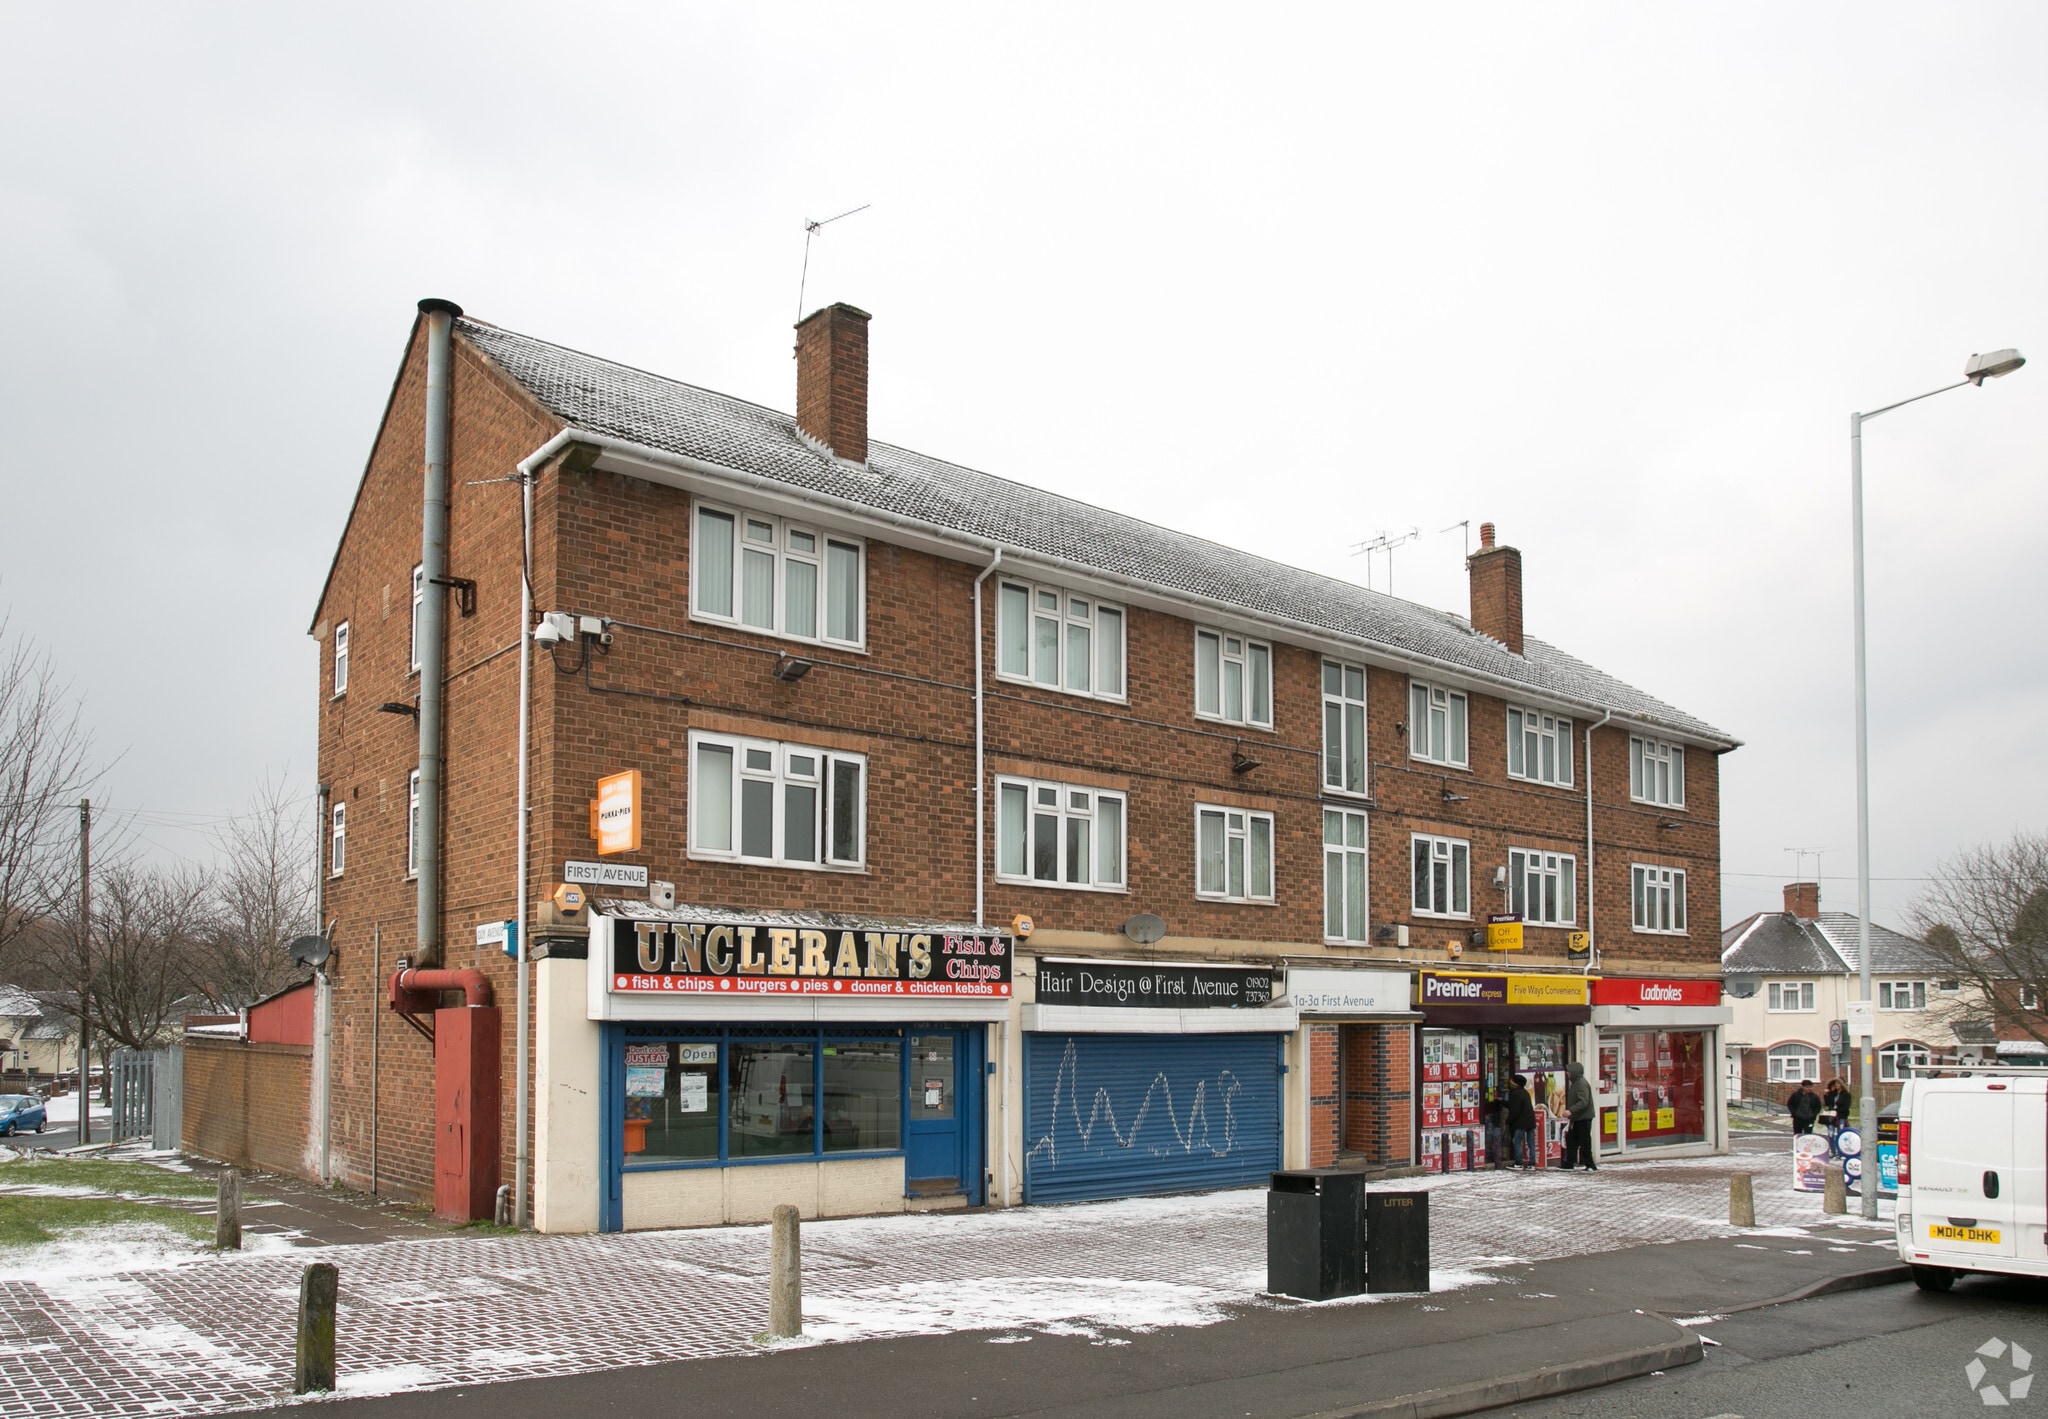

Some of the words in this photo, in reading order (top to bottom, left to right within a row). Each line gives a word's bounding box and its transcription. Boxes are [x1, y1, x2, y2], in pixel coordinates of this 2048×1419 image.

[567, 865, 598, 879] FIRST
[603, 868, 645, 882] AVENUE
[1498, 928, 1510, 936] Off
[634, 921, 932, 979] UNCLERAM'S
[942, 935, 986, 955] Fish
[990, 937, 1005, 956] &
[946, 958, 1001, 983] Chips
[632, 976, 659, 989] fish
[662, 977, 673, 990] &
[677, 977, 715, 992] chips
[737, 978, 787, 994] burgers
[803, 979, 829, 995] pies
[851, 980, 893, 993] donner
[895, 981, 904, 993] &
[909, 981, 952, 994] chicken
[955, 982, 993, 995] kebabs
[1040, 971, 1073, 993] Hair
[1080, 971, 1136, 1001] Design
[1138, 975, 1152, 994] @
[1154, 974, 1187, 995] First
[1191, 975, 1239, 996] Avenue
[1245, 977, 1269, 989] 01902
[1426, 978, 1482, 998] Premier
[1481, 988, 1503, 1000] express
[1245, 990, 1270, 1003] 737362
[1513, 984, 1526, 995] Five
[1527, 984, 1544, 997] Ways
[1544, 984, 1582, 996] Convenience
[1640, 984, 1682, 1001] Ladbrokes
[1293, 994, 1319, 1006] 1a-3a
[1322, 994, 1341, 1006] First
[1343, 994, 1375, 1007] Avenue
[627, 1054, 649, 1063] JUST
[650, 1054, 667, 1063] EAT
[682, 1048, 716, 1061] Open
[1429, 1064, 1440, 1076] £10
[1449, 1063, 1457, 1076] £5
[1466, 1063, 1477, 1075] £10
[1429, 1109, 1438, 1123] £3
[1447, 1108, 1456, 1122] £3
[1467, 1108, 1474, 1120] £1
[1384, 1198, 1414, 1207] LITTER
[1937, 1227, 1964, 1239] MD14
[1968, 1229, 1993, 1241] DHK
